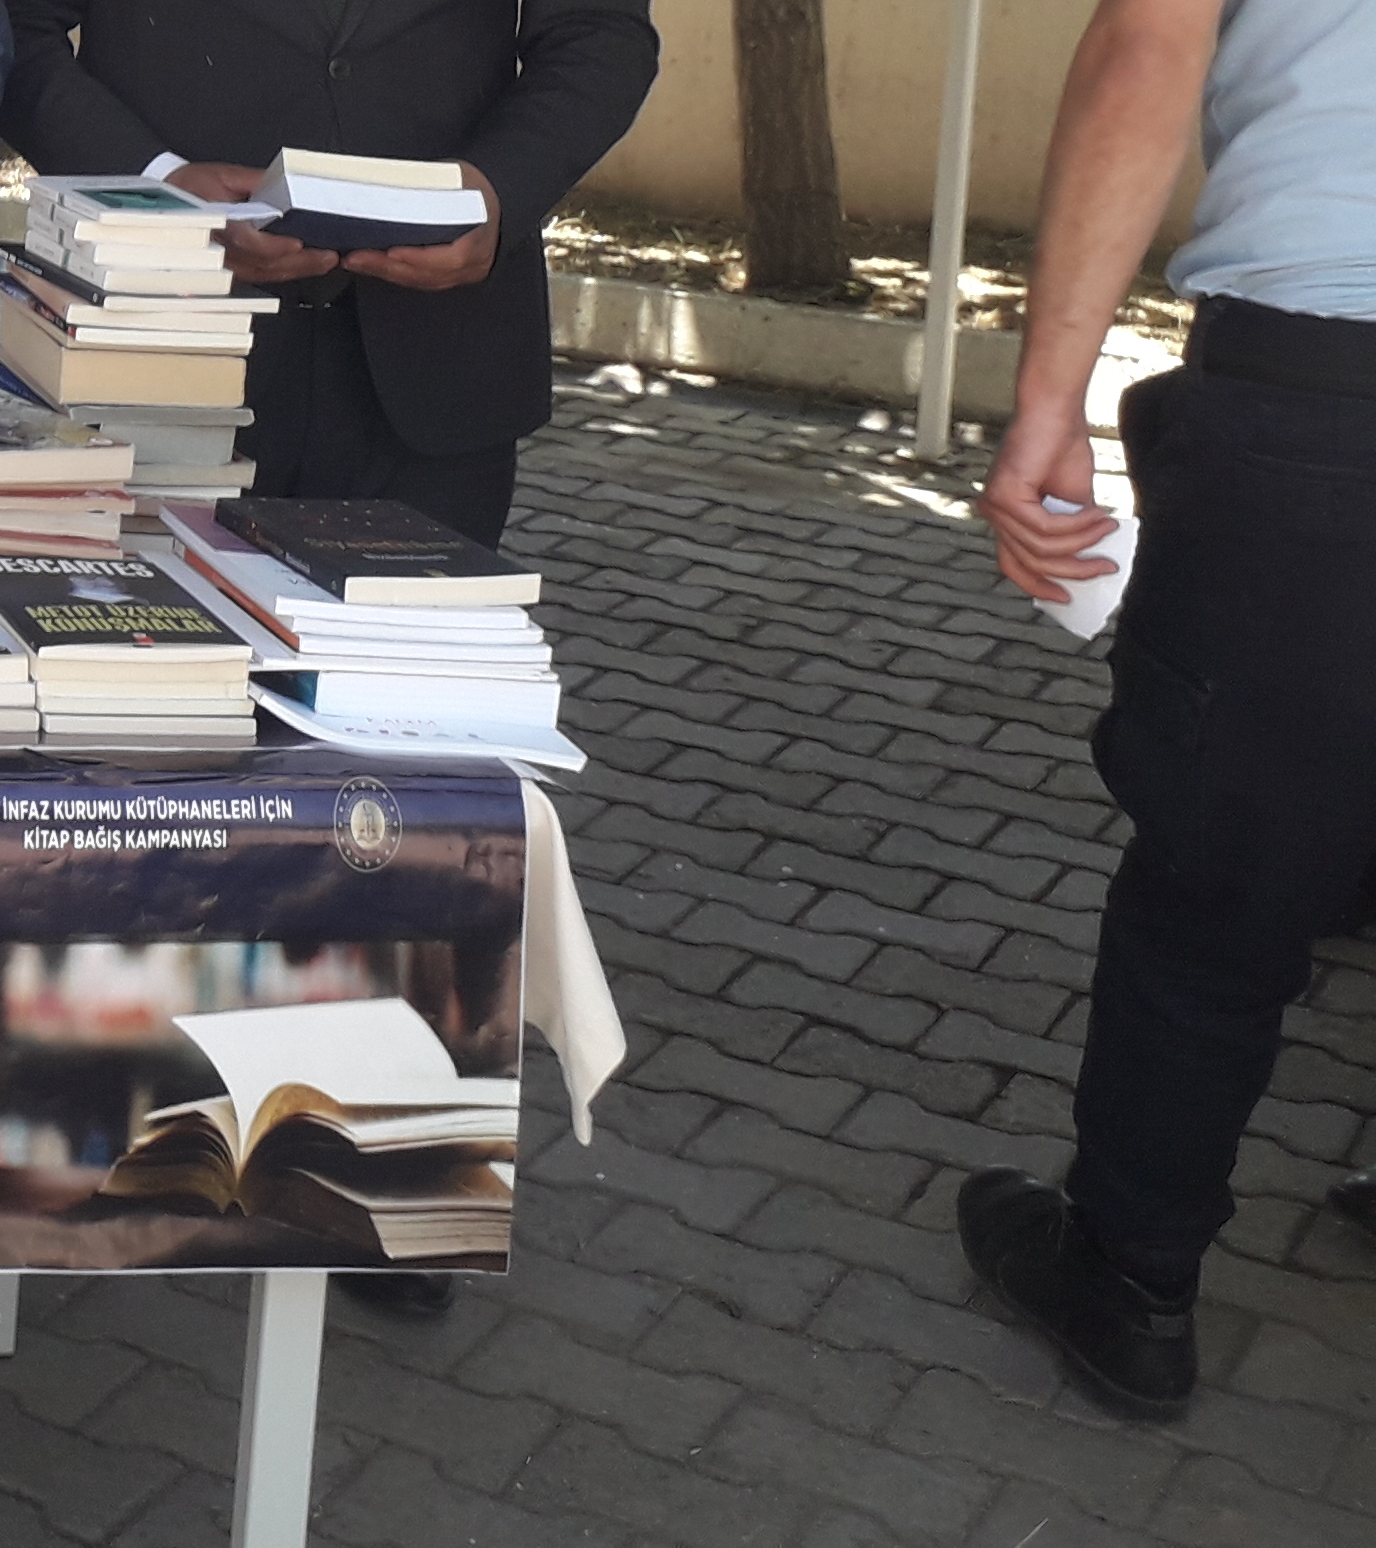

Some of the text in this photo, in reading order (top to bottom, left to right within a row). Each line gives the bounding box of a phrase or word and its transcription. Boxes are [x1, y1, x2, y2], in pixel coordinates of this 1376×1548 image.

[24, 604, 104, 620] METOT
[35, 616, 223, 635] KONUŞMALAR
[2, 795, 50, 821] İNFAZ
[53, 799, 122, 821] KURUMU
[125, 795, 257, 820] KÜTÜPHANELERİ
[259, 795, 293, 823] İÇİN
[23, 825, 227, 853] KİTAP BAĞIŞ KAMPANYASI
